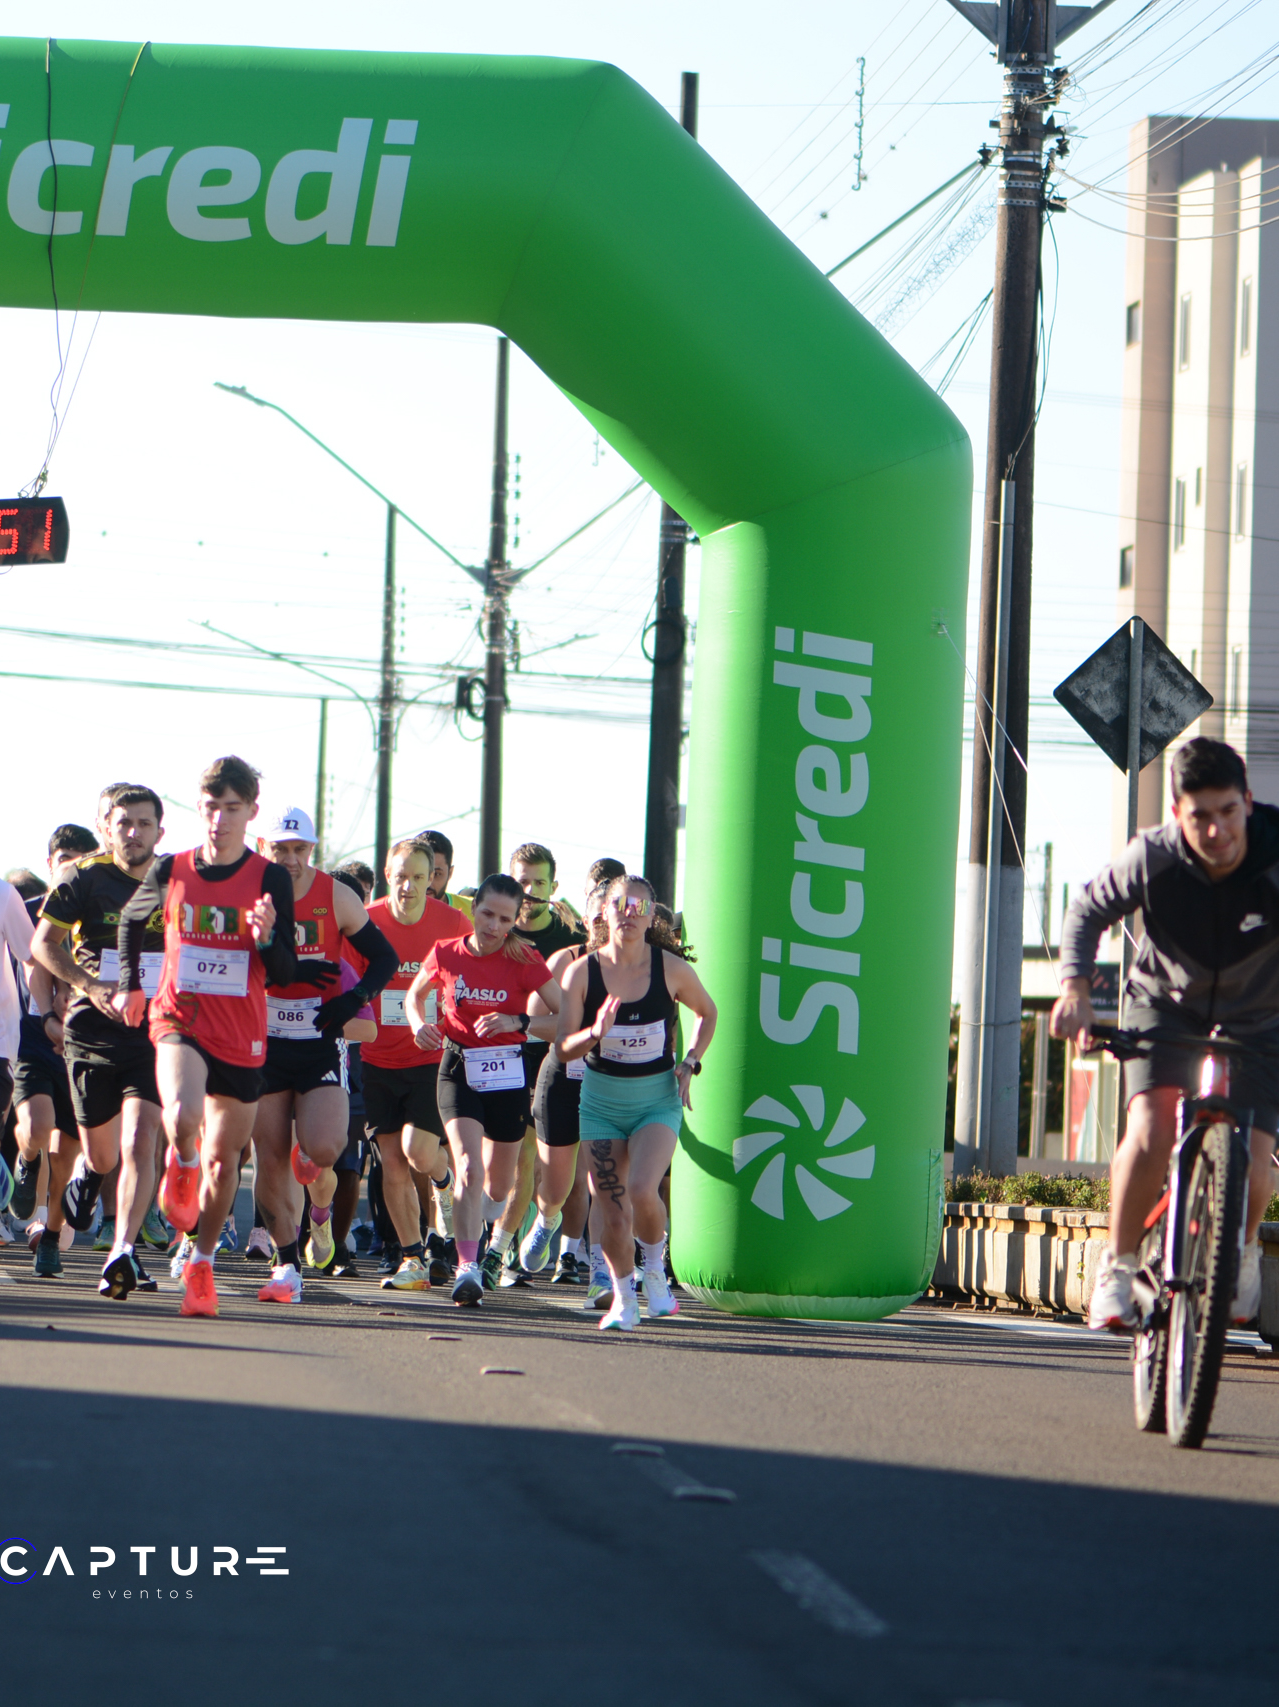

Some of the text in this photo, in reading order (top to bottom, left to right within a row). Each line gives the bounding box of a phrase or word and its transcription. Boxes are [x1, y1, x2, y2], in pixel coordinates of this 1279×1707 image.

[759, 625, 874, 1056] Sicredi
[197, 961, 228, 975] 072
[460, 987, 508, 1002] AASLO
[277, 1010, 304, 1021] 086
[620, 1037, 647, 1047] 125
[481, 1061, 506, 1072] 201
